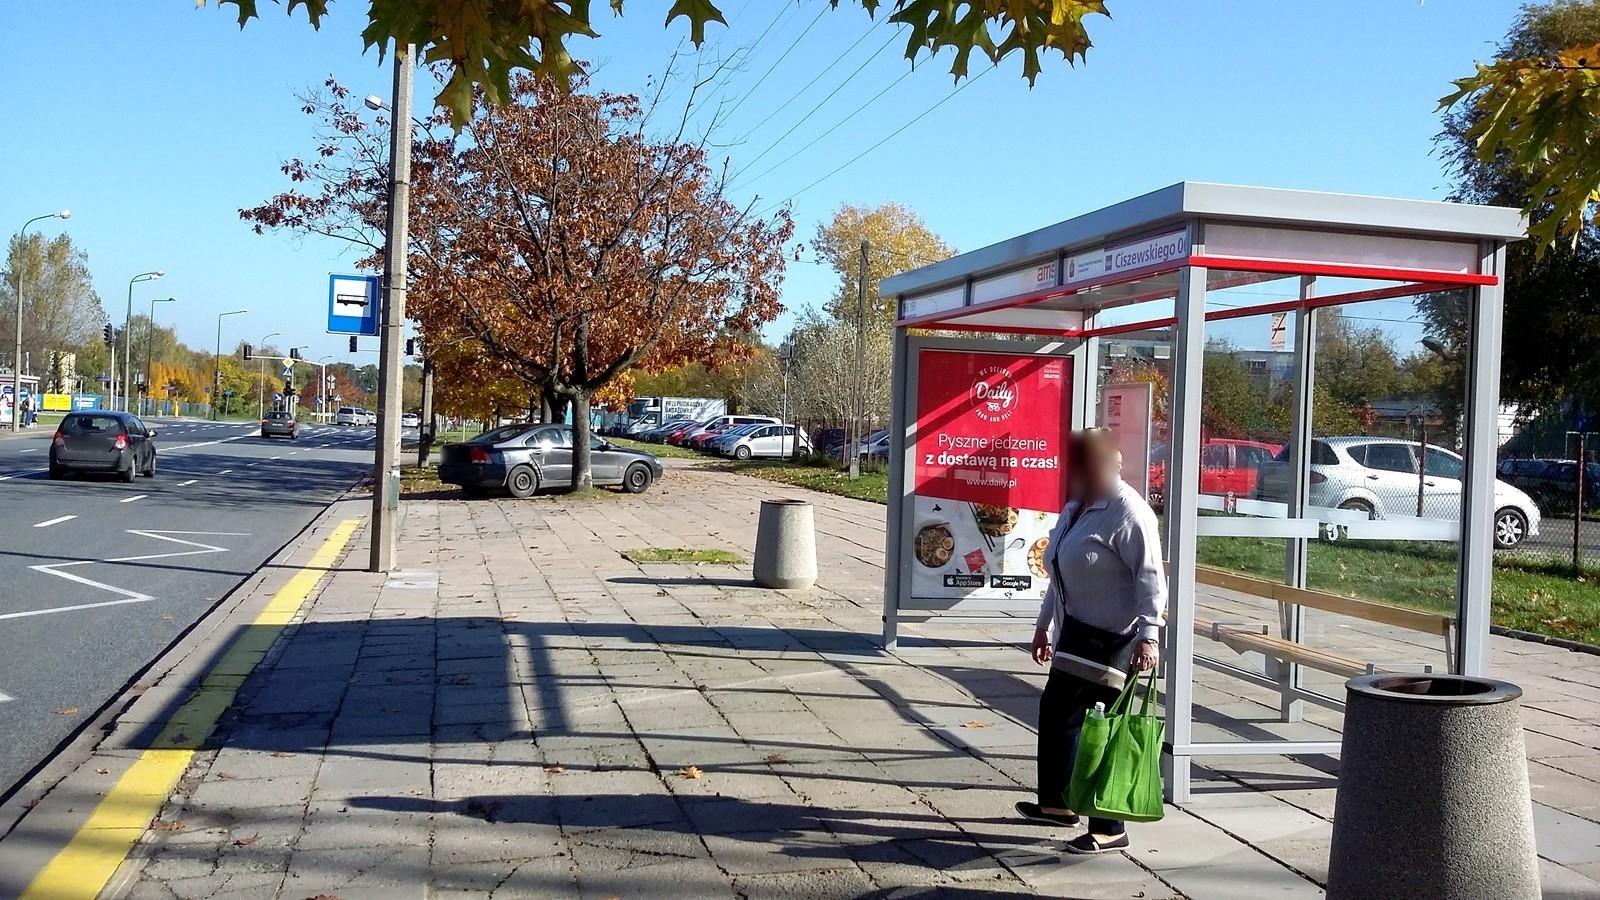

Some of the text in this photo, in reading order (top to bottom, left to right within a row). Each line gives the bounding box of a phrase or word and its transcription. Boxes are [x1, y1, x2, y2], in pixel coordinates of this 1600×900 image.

[1115, 241, 1175, 269] Ciszewskiego
[974, 381, 1014, 408] Daily
[938, 433, 1047, 452] Pyszne jedzenie
[925, 451, 1059, 470] z dostawą na czas!
[966, 478, 1017, 489] www.daily.pl
[1002, 579, 1019, 588] Google
